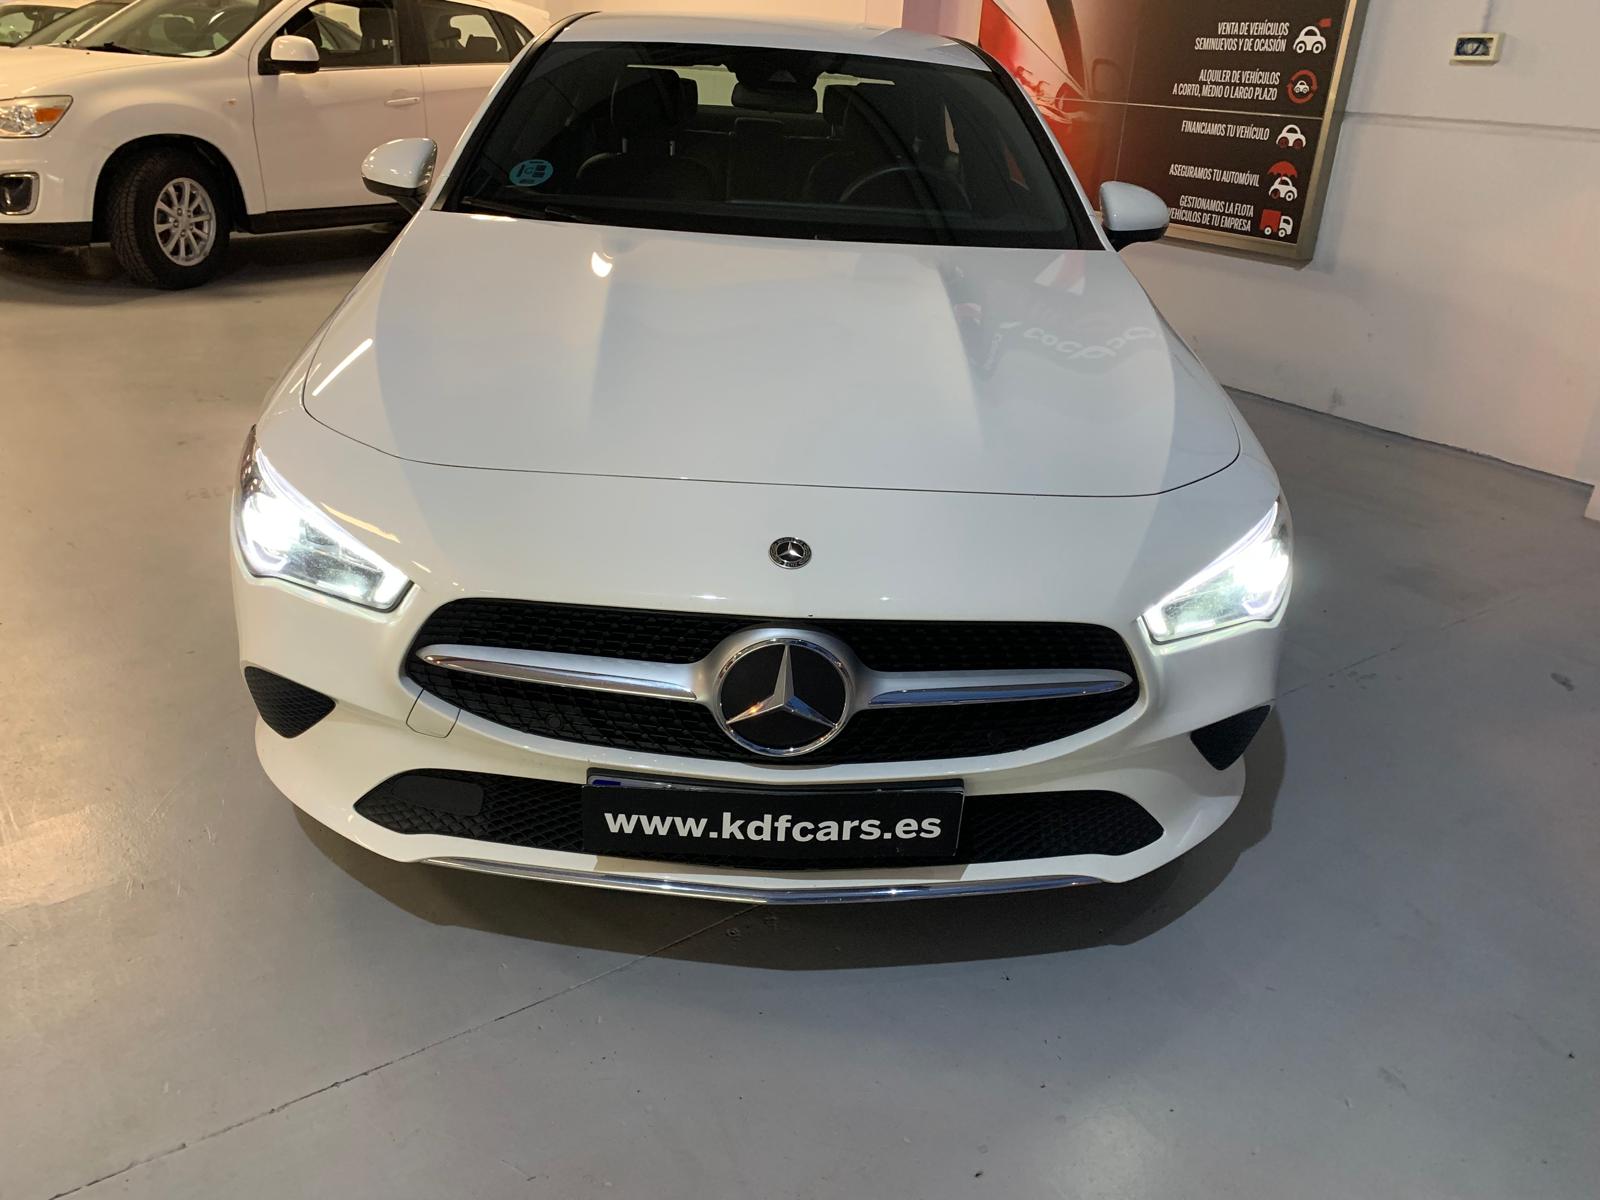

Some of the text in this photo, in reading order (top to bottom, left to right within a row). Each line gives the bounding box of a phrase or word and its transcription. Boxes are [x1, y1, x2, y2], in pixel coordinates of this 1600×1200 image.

[1218, 19, 1289, 36] VENTA DE VEHÍCULOS
[1195, 36, 1286, 52] SEMINUEVOS Y DE OCASIÓN
[1199, 68, 1280, 85] ALQUILER DE VEHÍCULOS
[1173, 83, 1277, 101] A CORTO, MEDIO O LARGO PLAZO
[1182, 120, 1270, 141] FINANCIAMOS TU VEHÍCULO
[1169, 164, 1260, 187] ASEGURAMOS TU AUTOMÓVIL
[1180, 195, 1254, 217] GESTIONAMOS LA FLOTA
[1201, 212, 1211, 225] DE
[1211, 214, 1220, 227] TU
[1220, 215, 1251, 232] EMPRESA
[604, 812, 941, 842] www.kdfcars.es
